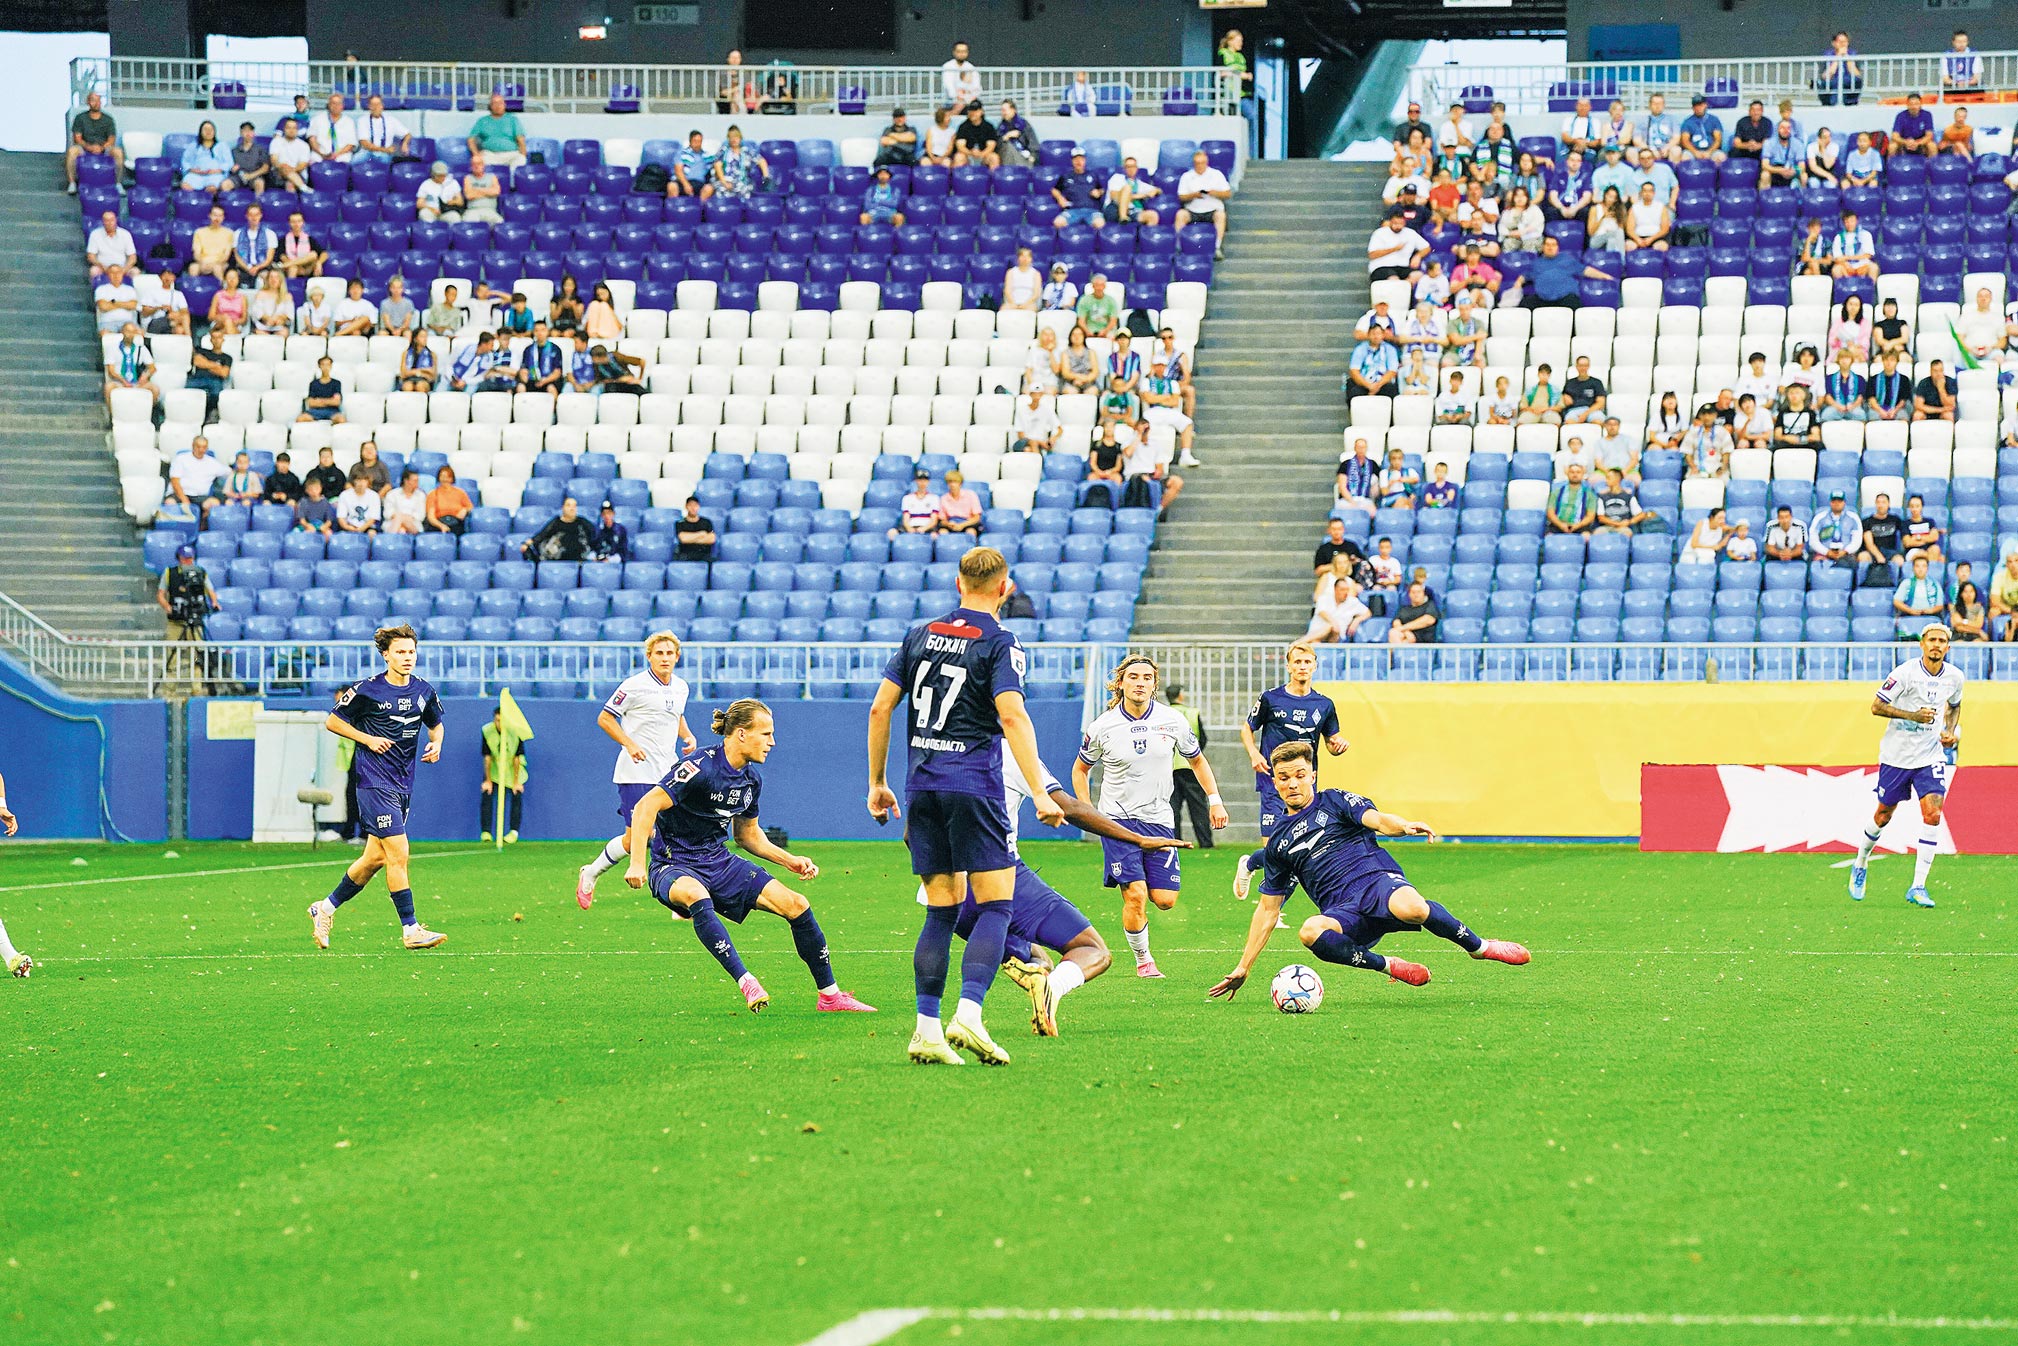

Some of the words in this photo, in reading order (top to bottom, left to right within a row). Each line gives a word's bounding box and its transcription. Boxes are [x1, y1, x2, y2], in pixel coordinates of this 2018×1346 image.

[926, 635, 967, 654] БОЖИН
[912, 660, 967, 731] 47
[378, 701, 392, 709] wb
[1274, 710, 1287, 718] wb
[710, 792, 724, 802] wb
[727, 797, 739, 805] BET
[377, 814, 391, 823] FON
[379, 821, 392, 829] BET
[1292, 820, 1308, 834] FON
[1293, 826, 1309, 840] BET
